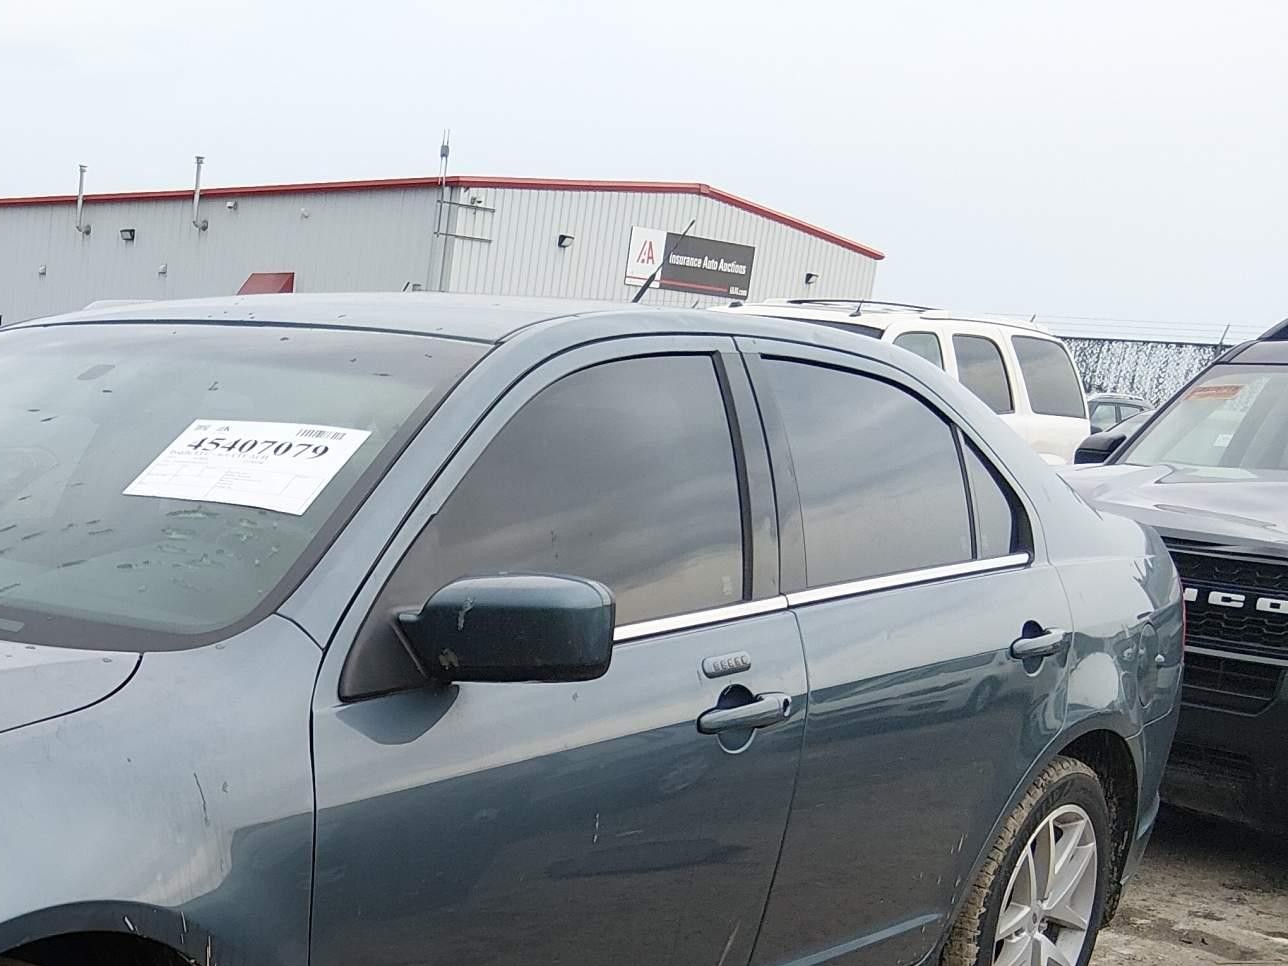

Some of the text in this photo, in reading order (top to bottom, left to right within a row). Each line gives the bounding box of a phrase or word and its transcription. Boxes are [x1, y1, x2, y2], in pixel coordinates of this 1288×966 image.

[669, 252, 747, 275] Insurance Auto Auctions
[187, 437, 330, 460] 45407079
